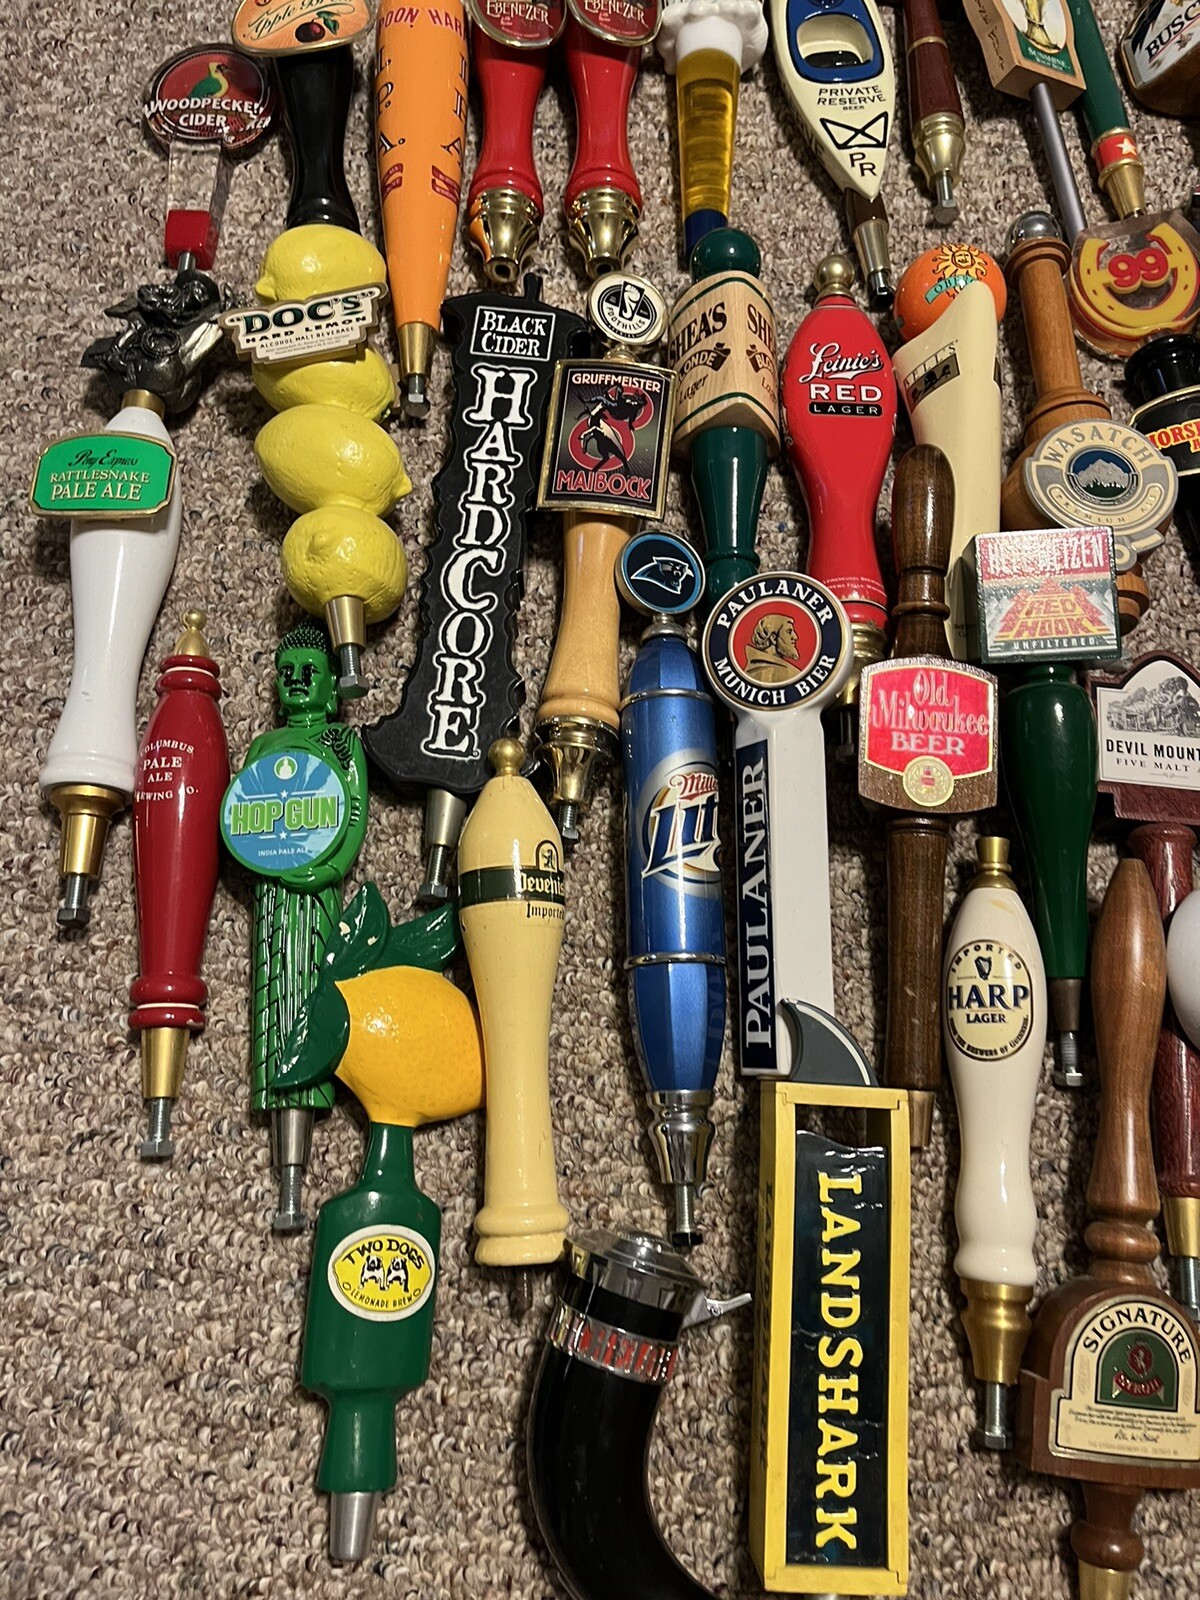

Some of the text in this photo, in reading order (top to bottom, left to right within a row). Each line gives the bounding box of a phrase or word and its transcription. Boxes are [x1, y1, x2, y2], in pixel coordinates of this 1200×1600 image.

[1145, 0, 1200, 60] BUSC
[816, 94, 887, 106] RESERVE
[818, 85, 882, 97] PRIVATE
[178, 113, 228, 128] CIDER
[1107, 246, 1171, 291] 99
[245, 330, 295, 344] HARD
[304, 315, 368, 332] LEMON
[480, 310, 548, 337] BLACK
[606, 306, 646, 330] FOOTHILLS
[259, 338, 294, 349] ALCOHOL
[295, 333, 315, 343] MALT
[316, 326, 355, 338] BEVERAGE
[480, 331, 541, 358] CIDER
[679, 350, 719, 382] LONDE
[798, 342, 885, 384] Leinie's
[571, 372, 662, 394] GRUFFMEISTER
[678, 373, 709, 405] Lager
[809, 383, 883, 402] RED
[813, 403, 879, 415] LAGER
[1043, 425, 1155, 464] WASATCH
[50, 469, 151, 484] RATTLESNAKE
[555, 470, 652, 500] MAIBOCK
[51, 482, 142, 501] PALE ALE
[717, 579, 834, 629] PAULANER
[1024, 597, 1078, 617] RED
[1013, 615, 1091, 639] HOOK
[714, 654, 837, 706] MUNICH BIER
[913, 670, 951, 707] Old
[872, 689, 989, 736] Milwaukee
[890, 731, 966, 756] BEER
[1105, 738, 1149, 757] DEVIL
[143, 756, 183, 771] PALE
[147, 771, 174, 783] ALE
[1116, 757, 1147, 769] FIVE
[1153, 761, 1191, 773] MALT
[230, 795, 340, 836] HOP GUN
[643, 793, 719, 877] Lit
[258, 849, 279, 858] INDIA
[279, 847, 296, 857] PALE
[742, 757, 772, 1049] PAULANER
[951, 944, 1022, 973] IMPORTED
[948, 984, 1030, 1011] HARP
[966, 1013, 1007, 1025] LAGER
[342, 1238, 425, 1270] TWO DOGS
[350, 1289, 414, 1309] LEMONADE BREW
[1083, 1307, 1192, 1365] SIGNATURE
[816, 1170, 865, 1551] LANDSHARK
